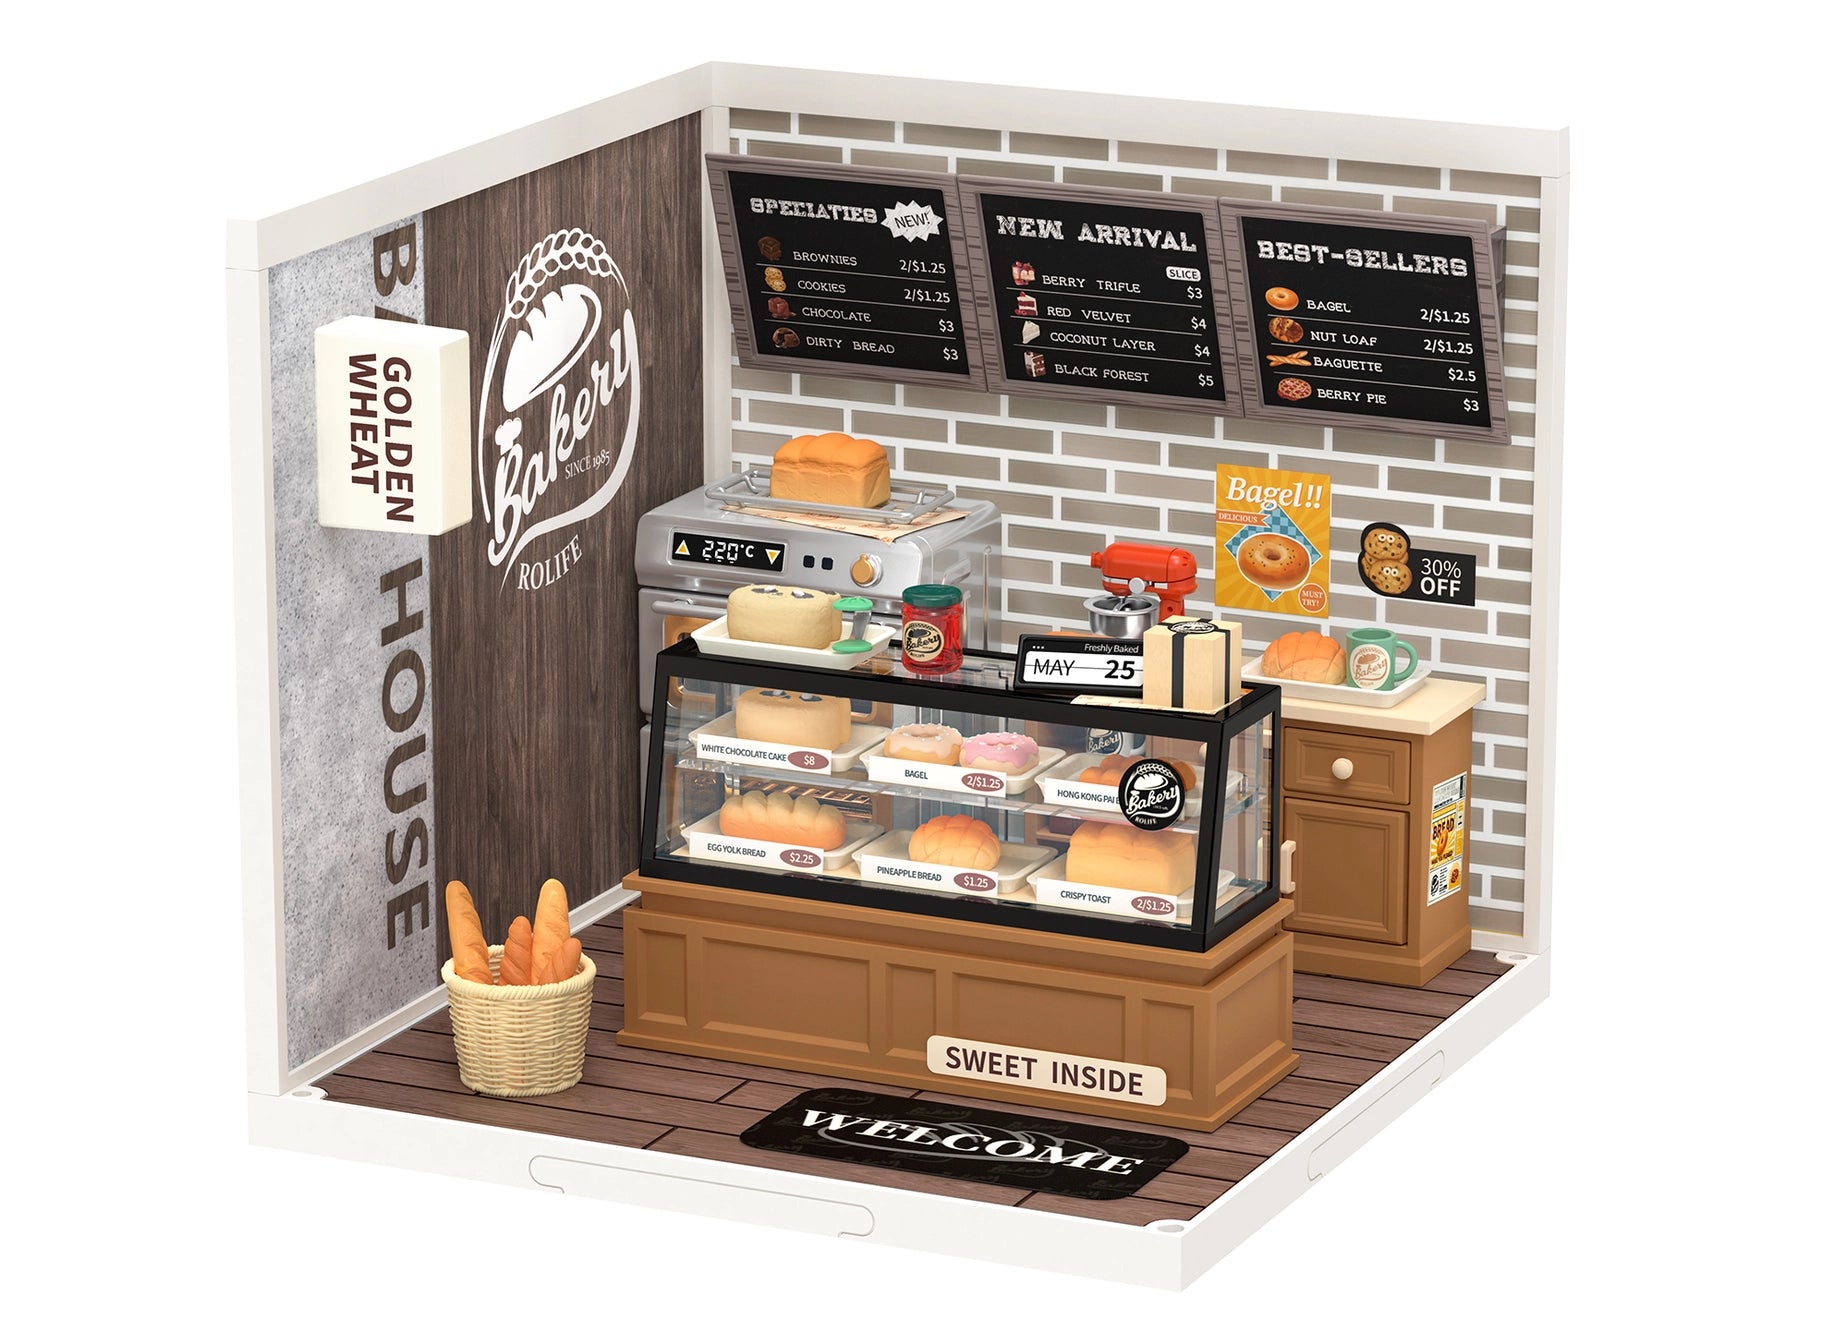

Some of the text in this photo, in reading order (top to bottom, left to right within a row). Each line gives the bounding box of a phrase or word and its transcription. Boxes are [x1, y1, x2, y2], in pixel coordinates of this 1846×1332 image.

[894, 212, 931, 230] NEW!
[996, 215, 1197, 252] NEW ARRIVAL
[793, 250, 857, 266] BROWNIES
[1257, 239, 1468, 278] BEST-SELLERS
[899, 259, 946, 275] 2/$1.25
[1169, 268, 1199, 280] SLICE
[797, 280, 846, 294] COOKIES
[1042, 275, 1141, 293] BERRY TRIFLE
[903, 289, 950, 303] 2/$1.25
[1187, 286, 1203, 300] $3
[1306, 300, 1351, 313] BAGEL
[801, 307, 872, 323] CHOCOLATE
[1047, 306, 1131, 324] RED VELVET
[1420, 308, 1471, 325] 2/$1.25
[938, 319, 955, 333] $3
[1191, 317, 1207, 330] $4
[806, 336, 896, 354] DIRTY BREAD
[1050, 332, 1156, 351] COCONUT LAYER
[1310, 331, 1378, 347] NUT LOAF
[1423, 339, 1474, 355] 2/$1.25
[943, 347, 959, 361] $3
[1194, 344, 1211, 358] $4
[1313, 357, 1383, 373] BAGUETTE
[1054, 364, 1150, 383] BLACK FOREST
[1198, 373, 1214, 388] $5
[1448, 368, 1476, 382] $2.5
[1317, 388, 1387, 405] BERRY PIE
[1463, 399, 1479, 412] $3
[348, 353, 380, 494] WHEAT
[382, 357, 414, 523] GOLDEN
[488, 308, 640, 566] Bakery
[564, 450, 611, 480] SINCE 1985
[1218, 512, 1258, 524] DELICIOUS
[517, 534, 583, 590] ROLIFE
[1420, 557, 1462, 578] 30%
[1302, 589, 1324, 599] MUST
[1420, 577, 1461, 598] OFF
[1302, 599, 1320, 608] TRY!
[1084, 643, 1139, 654] Freshly Baked
[1033, 658, 1076, 676] MAY
[1104, 660, 1136, 680] 25
[380, 557, 430, 951] HOUSE
[701, 743, 787, 762] WHITE CHOCOLATE CAKE
[803, 754, 816, 767] $8
[904, 769, 928, 780] BAGEL
[966, 775, 1001, 789] 2/$1.25
[1057, 789, 1079, 801] HONG
[1080, 791, 1103, 802] KONG
[1103, 794, 1115, 804] PAI
[1126, 785, 1180, 814] Bakery
[707, 843, 766, 858] EGG YOLK BREAD
[789, 852, 814, 866] $2.25
[877, 866, 942, 882] PINEAPPLE BREAD
[963, 875, 988, 889] $1.25
[1060, 890, 1111, 904] CRISPY TOAST
[1137, 898, 1171, 913] 2/$1.25
[945, 1045, 1144, 1097] SWEET INSIDE
[800, 1108, 1144, 1176] WELCOME
